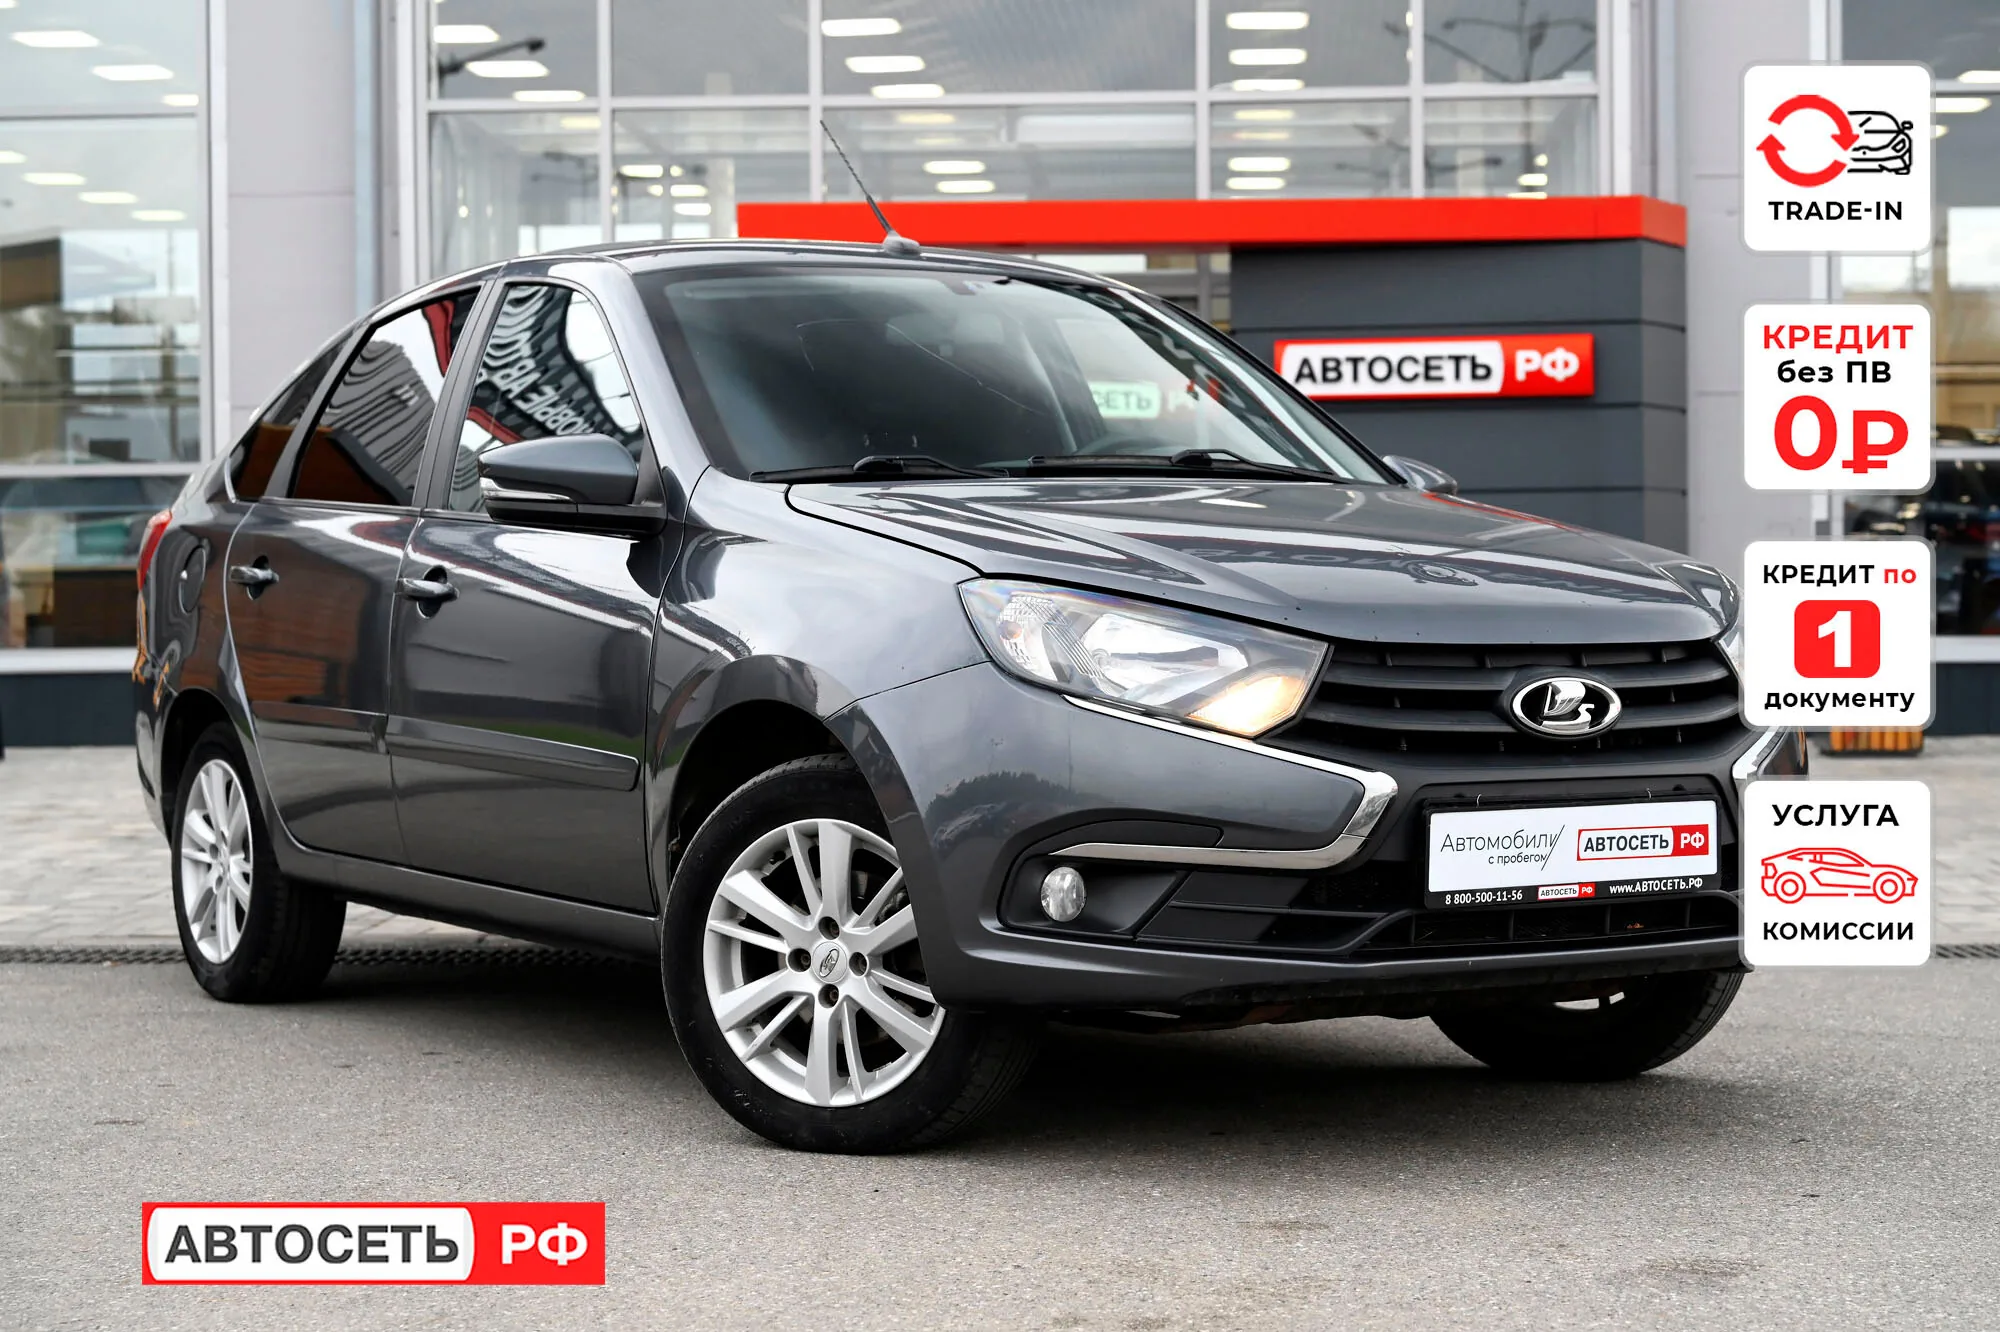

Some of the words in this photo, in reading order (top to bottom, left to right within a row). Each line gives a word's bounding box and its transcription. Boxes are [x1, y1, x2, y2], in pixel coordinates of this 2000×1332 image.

[1294, 354, 1493, 384] АВТОСЕТЬ
[1514, 347, 1581, 382] РФ
[1440, 828, 1561, 853] Автомобили
[1583, 833, 1670, 852] АВТОСЕТЬ
[1680, 831, 1705, 849] РФ
[1487, 855, 1495, 865] с
[1497, 851, 1549, 866] пробегом
[1540, 888, 1578, 897] АВТОСЕТЬ
[1581, 886, 1593, 894] РФ
[1609, 877, 1703, 894] www.АВТОСЕТЬ.РФ
[1445, 893, 1451, 905] 8
[1453, 889, 1523, 904] 800-500-11-56
